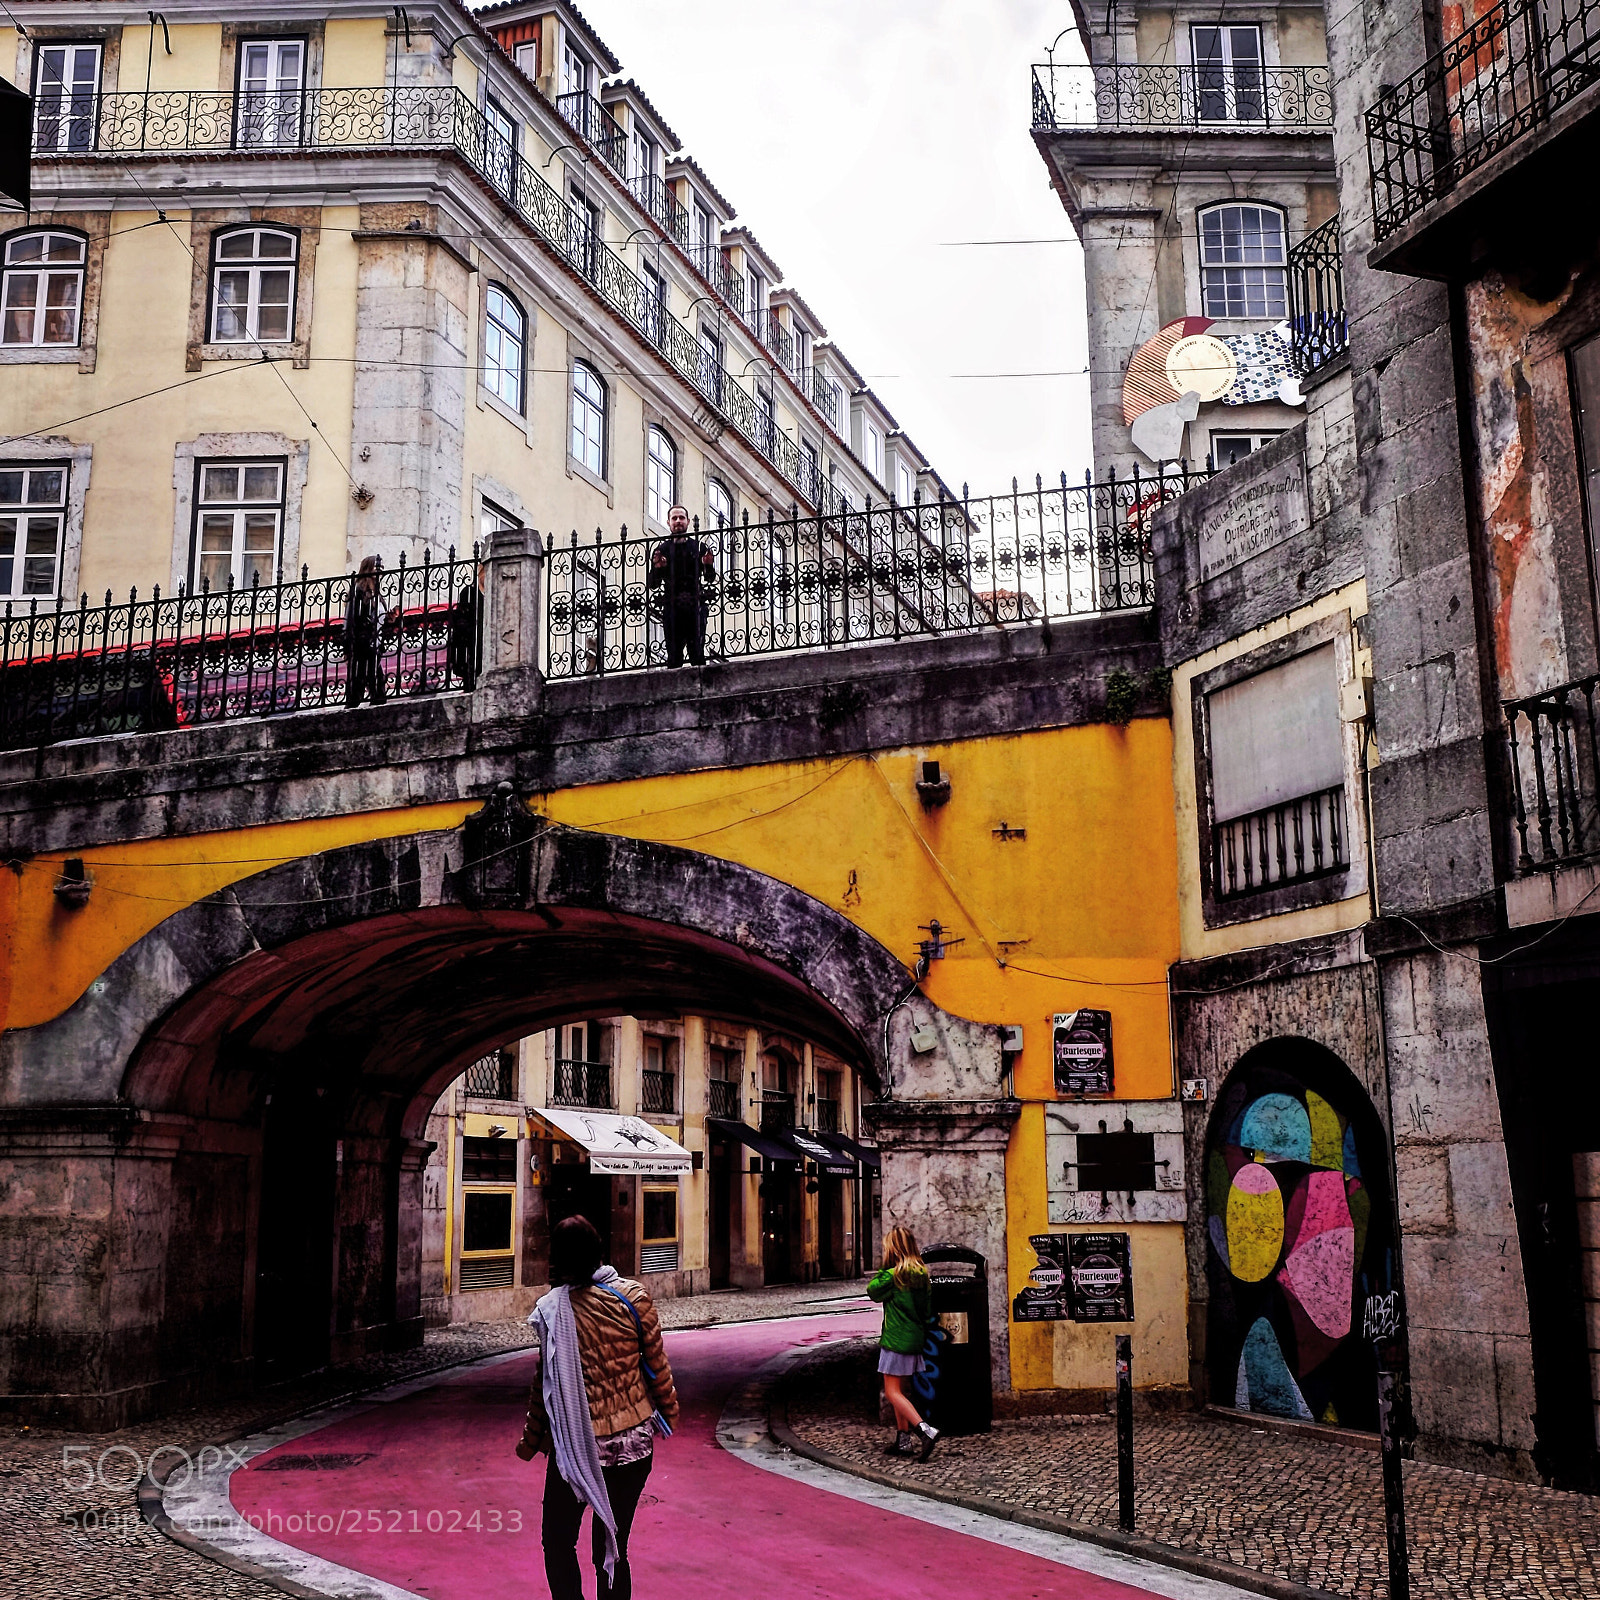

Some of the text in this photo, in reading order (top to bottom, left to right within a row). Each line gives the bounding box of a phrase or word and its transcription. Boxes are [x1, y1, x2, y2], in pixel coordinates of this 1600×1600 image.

[1063, 1047, 1101, 1056] Burlesque
[1029, 1273, 1060, 1282] rlesque
[1079, 1272, 1119, 1282] Burlesque
